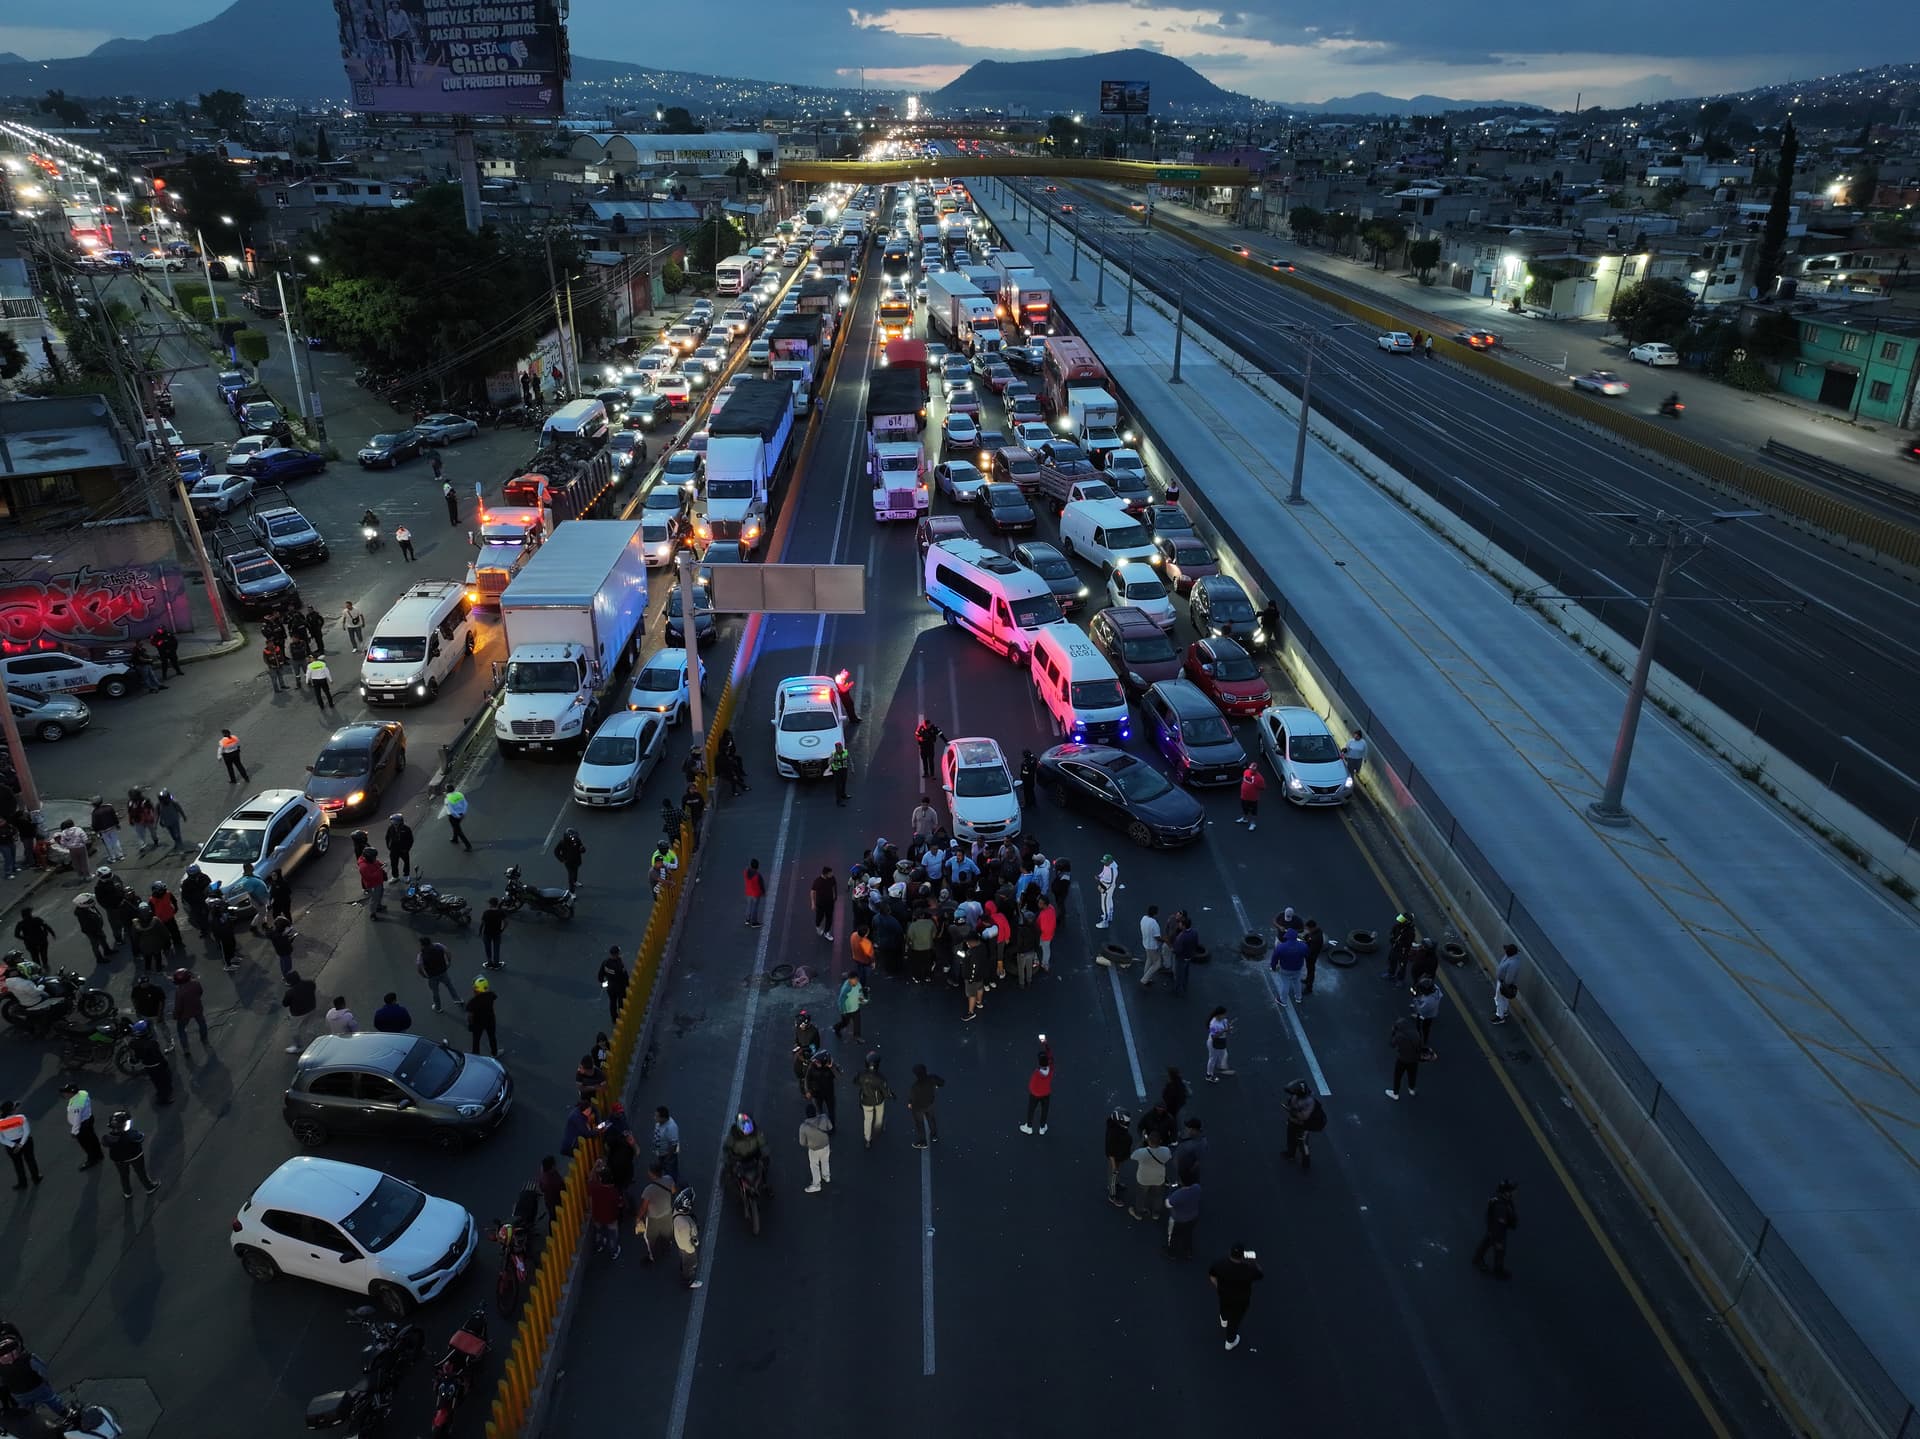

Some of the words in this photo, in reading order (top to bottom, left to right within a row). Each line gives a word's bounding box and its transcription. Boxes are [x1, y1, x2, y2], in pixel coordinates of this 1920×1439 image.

[427, 10, 471, 25] NUEVAS
[473, 7, 519, 22] FORMAS
[521, 5, 536, 20] DE
[430, 28, 462, 41] PASAR
[464, 26, 499, 38] TIEMPO
[501, 23, 538, 37] JUNTOS.
[449, 43, 470, 57] NO
[472, 42, 499, 55] ESTÁ
[443, 78, 462, 90] QUE
[463, 75, 506, 88] PRUEBEN
[507, 74, 543, 87] FUMAR.
